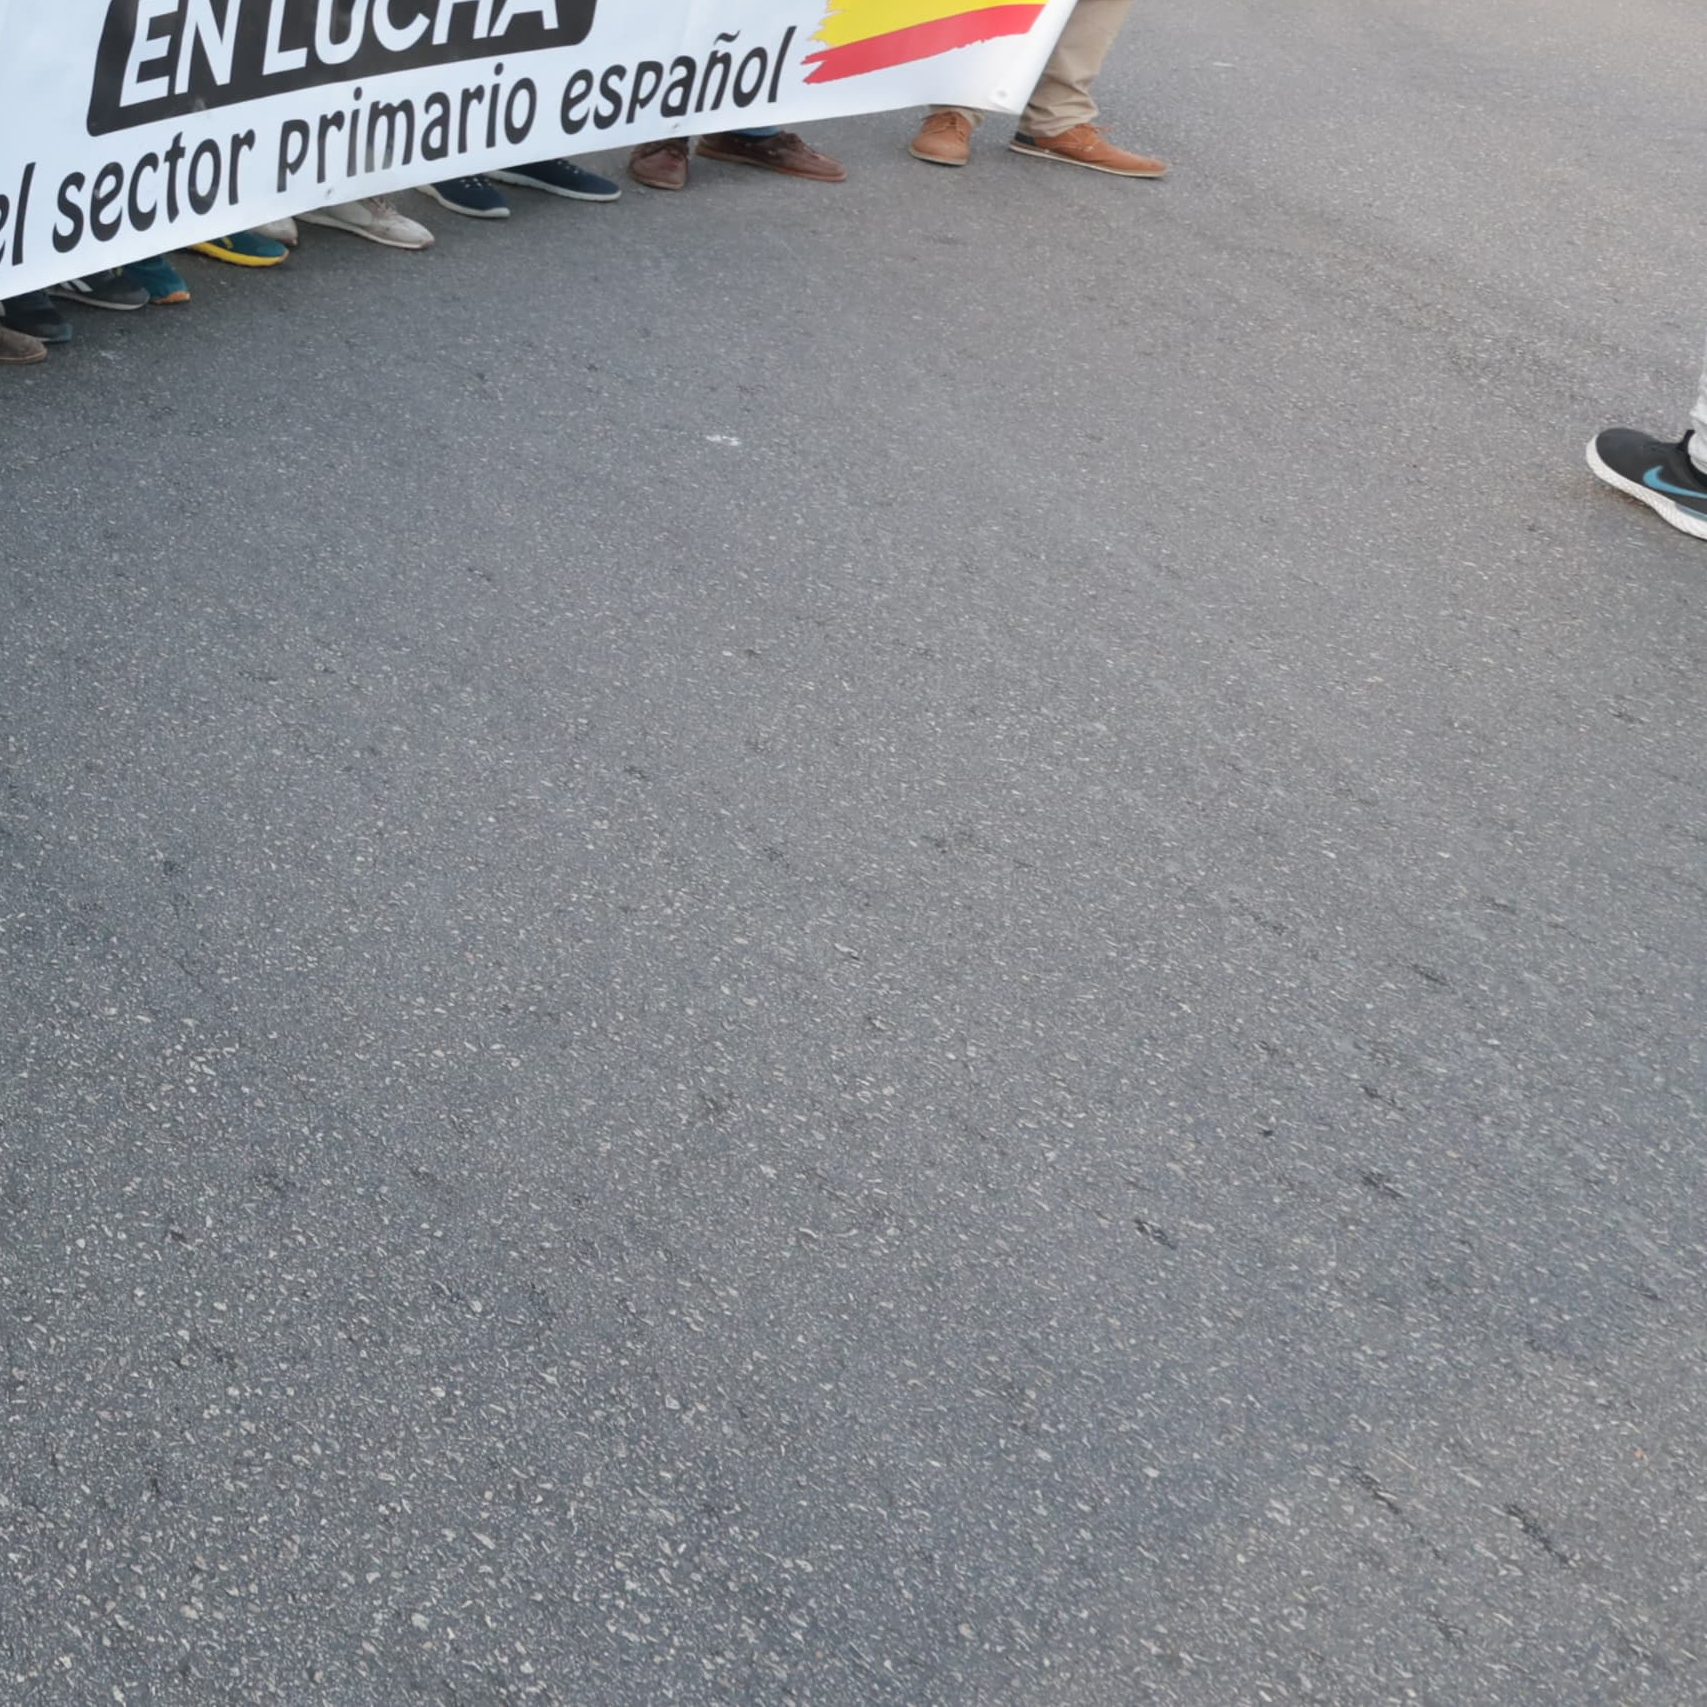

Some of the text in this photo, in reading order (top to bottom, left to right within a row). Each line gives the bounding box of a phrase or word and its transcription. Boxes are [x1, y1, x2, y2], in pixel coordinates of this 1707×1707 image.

[52, 126, 257, 254] sector
[277, 62, 535, 193] primario
[559, 24, 796, 135] español
